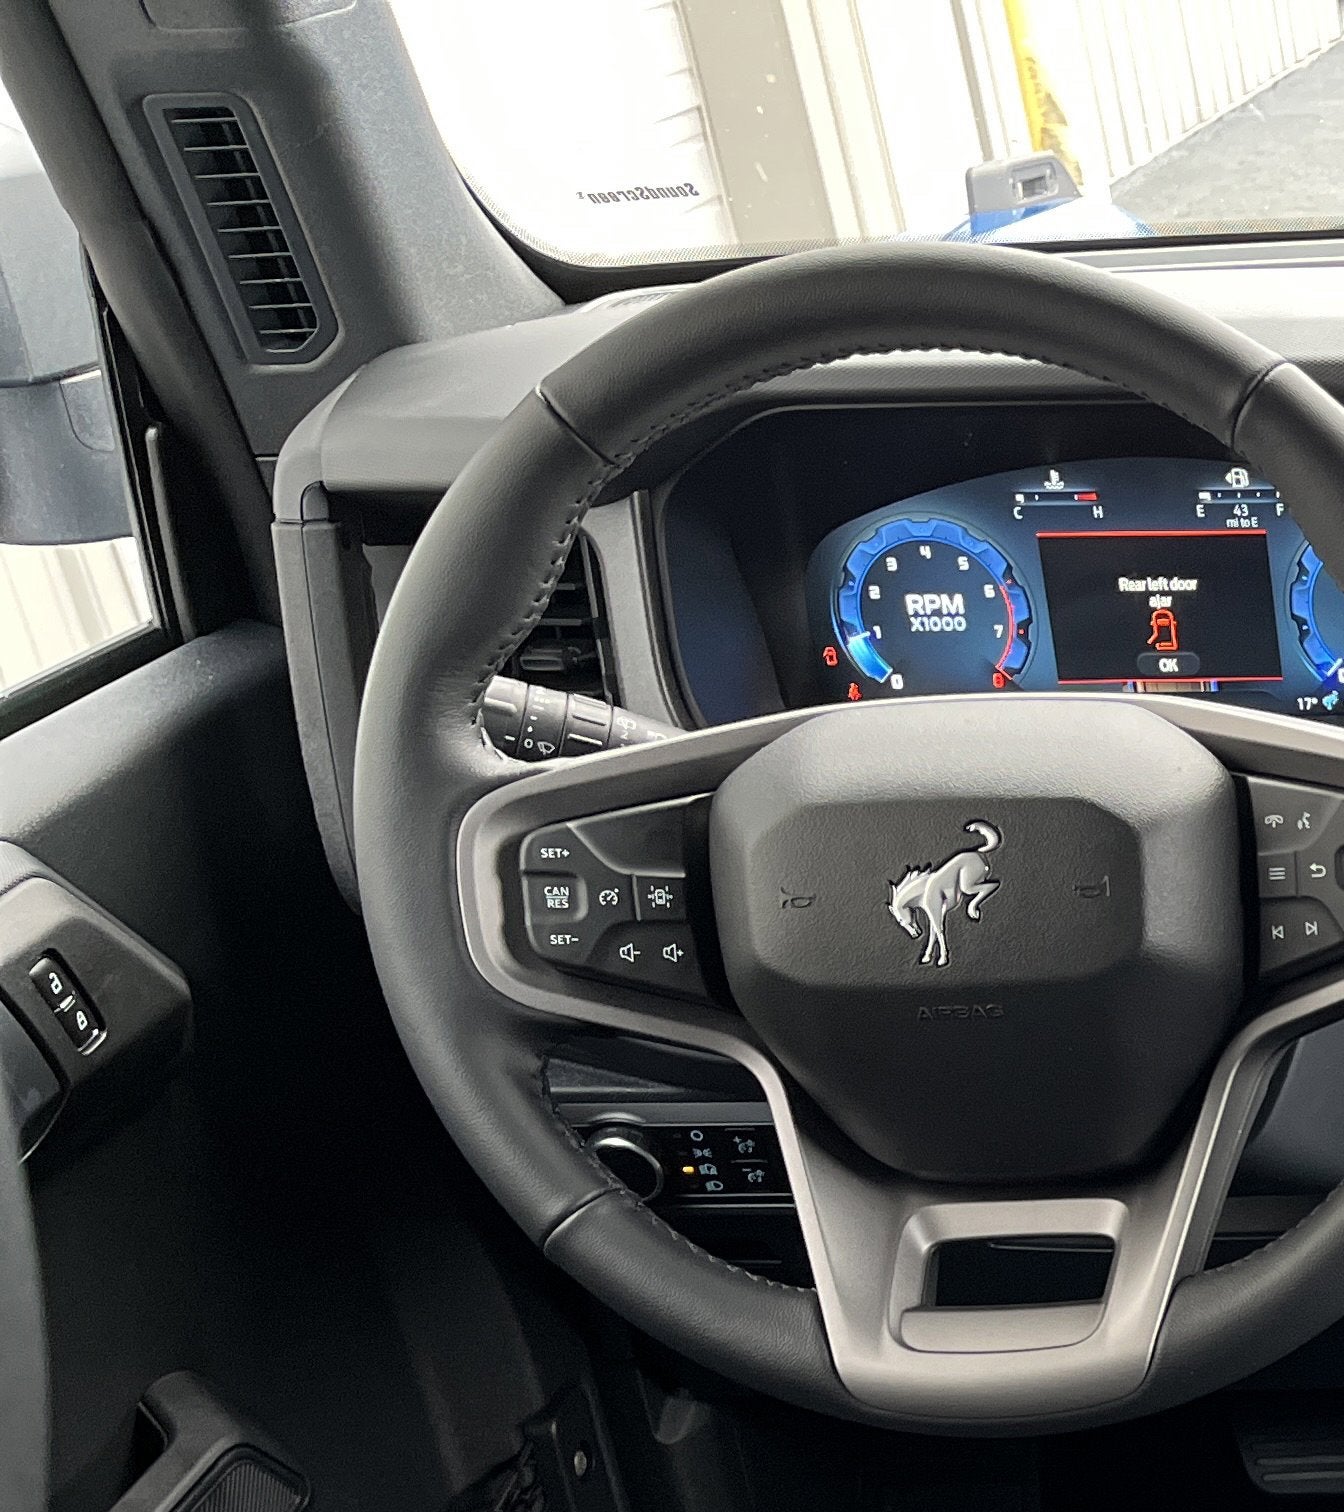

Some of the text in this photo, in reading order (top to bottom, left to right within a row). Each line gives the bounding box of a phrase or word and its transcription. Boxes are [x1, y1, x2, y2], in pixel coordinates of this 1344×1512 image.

[1013, 506, 1023, 519] C
[1092, 505, 1103, 519] H
[1196, 504, 1205, 517] E
[1233, 504, 1249, 517] 43
[1275, 503, 1284, 516] F
[1226, 517, 1258, 528] mi to E
[919, 545, 932, 560] 4
[885, 556, 898, 572] 3
[957, 556, 970, 571] 5
[983, 584, 996, 598] 6
[1118, 576, 1198, 592] Rear left door
[868, 585, 881, 600] 2
[905, 593, 965, 616] RPM
[1149, 594, 1173, 609] ajar
[910, 616, 967, 632] X1000
[993, 624, 1004, 639] 7
[872, 625, 882, 640] 1
[1158, 658, 1179, 673] OK
[890, 674, 904, 690] 0
[540, 848, 570, 859] SET+
[544, 886, 570, 896] CAN
[546, 898, 570, 909] RES
